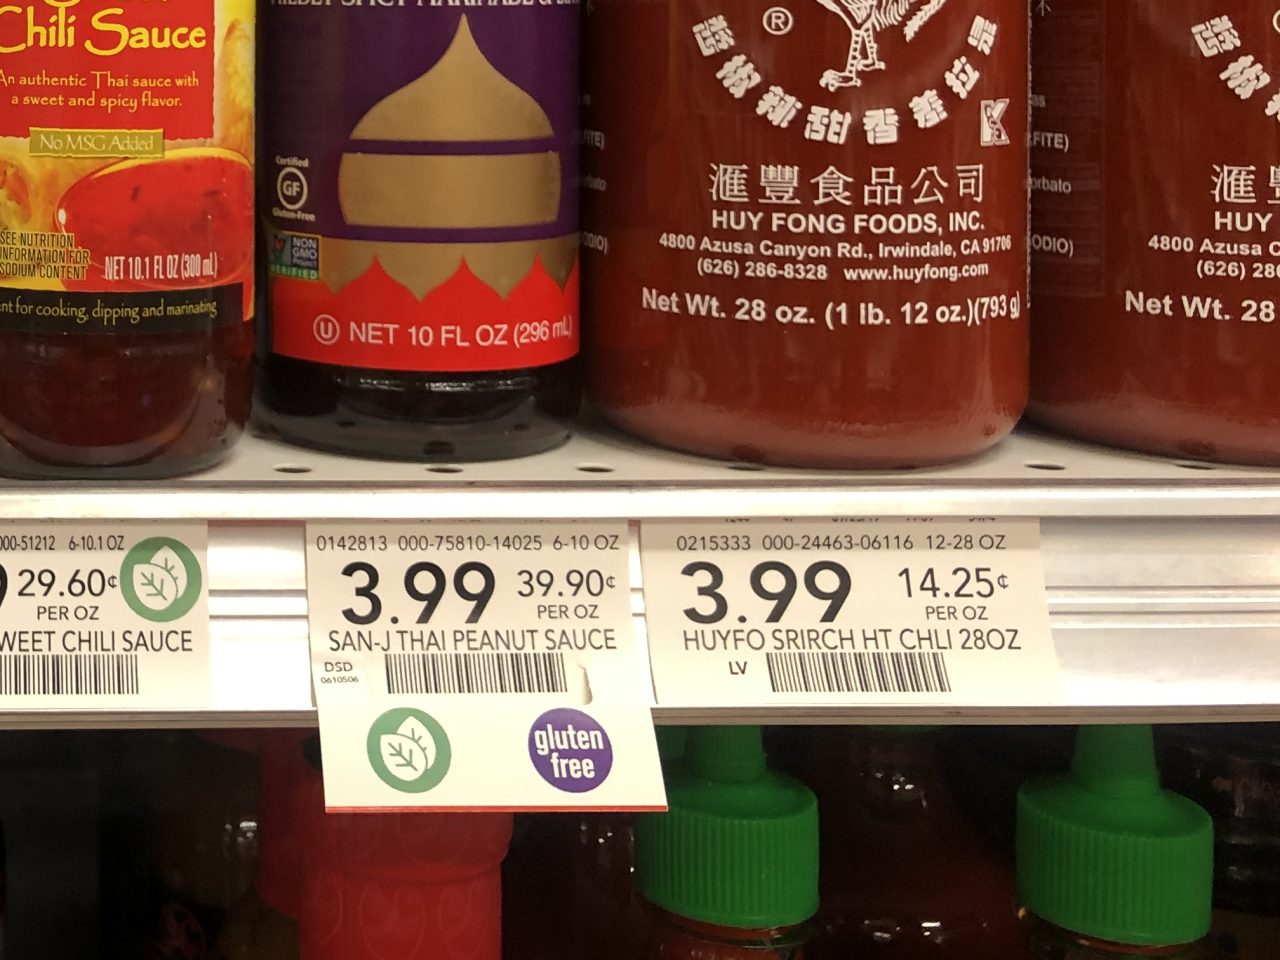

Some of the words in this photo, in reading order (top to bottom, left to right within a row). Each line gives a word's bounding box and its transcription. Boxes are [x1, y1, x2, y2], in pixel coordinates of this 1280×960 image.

[84, 8, 206, 56] Sauce
[18, 70, 87, 87] authentic
[141, 91, 183, 107] flavor.
[39, 133, 63, 150] No
[66, 133, 107, 151] MSG
[110, 133, 153, 151] Added
[282, 180, 300, 196] GF
[712, 210, 763, 231] HUY
[772, 212, 844, 234] FONG
[854, 213, 942, 236] FOODS,
[949, 211, 984, 232] INC.
[1214, 211, 1272, 232] HUY
[20, 233, 74, 248] NUTRITION
[292, 237, 317, 249] NON
[659, 233, 695, 250] 4800
[700, 237, 753, 255] Azusa
[759, 240, 834, 260] Canyon
[838, 243, 873, 259] Rd.,
[961, 240, 980, 255] CA
[1148, 234, 1193, 252] 4800
[1200, 238, 1261, 256] Azusa
[0, 247, 66, 264] INFORMATION
[292, 247, 317, 259] GMO
[0, 262, 37, 277] SODIUM
[39, 264, 86, 280] CONTENT
[105, 257, 126, 281] NET
[128, 256, 152, 280] 10.1
[697, 260, 740, 278] (626)
[745, 262, 827, 280] 286-8328
[844, 262, 988, 283] www.huyfong.com
[1197, 259, 1245, 280] (626)
[36, 298, 89, 323] cooking,
[92, 298, 140, 322] dipping
[143, 299, 164, 317] and
[167, 297, 218, 318] marinating
[642, 287, 678, 313] Net
[685, 293, 726, 317] Wt.
[735, 299, 765, 322] 28
[1125, 290, 1172, 316] Net
[350, 321, 399, 344] NET
[316, 535, 388, 552] 0142813
[398, 535, 543, 551] 000-75810-14025
[552, 535, 590, 551] 6-10
[676, 535, 751, 551] 0215333
[762, 535, 914, 551] 000-24463-06116
[926, 535, 973, 550] 12-28
[340, 561, 496, 626] 3.99
[681, 560, 852, 624] 3.99
[37, 606, 69, 621] PER
[537, 605, 570, 620] PER
[925, 606, 958, 621] PER
[62, 630, 116, 653] CHILI
[122, 630, 193, 652] SAUCE
[328, 630, 391, 652] SAN-J
[396, 630, 446, 652] THAI
[454, 630, 538, 651] PEANUT
[544, 629, 617, 650] SAUCE
[683, 629, 765, 651] HUYFO
[772, 629, 855, 651] SRIRCH
[863, 629, 892, 650] HT
[899, 629, 953, 651] CHLI
[959, 629, 1022, 650] 28OZ
[534, 724, 604, 756] gluten
[550, 753, 595, 779] free
